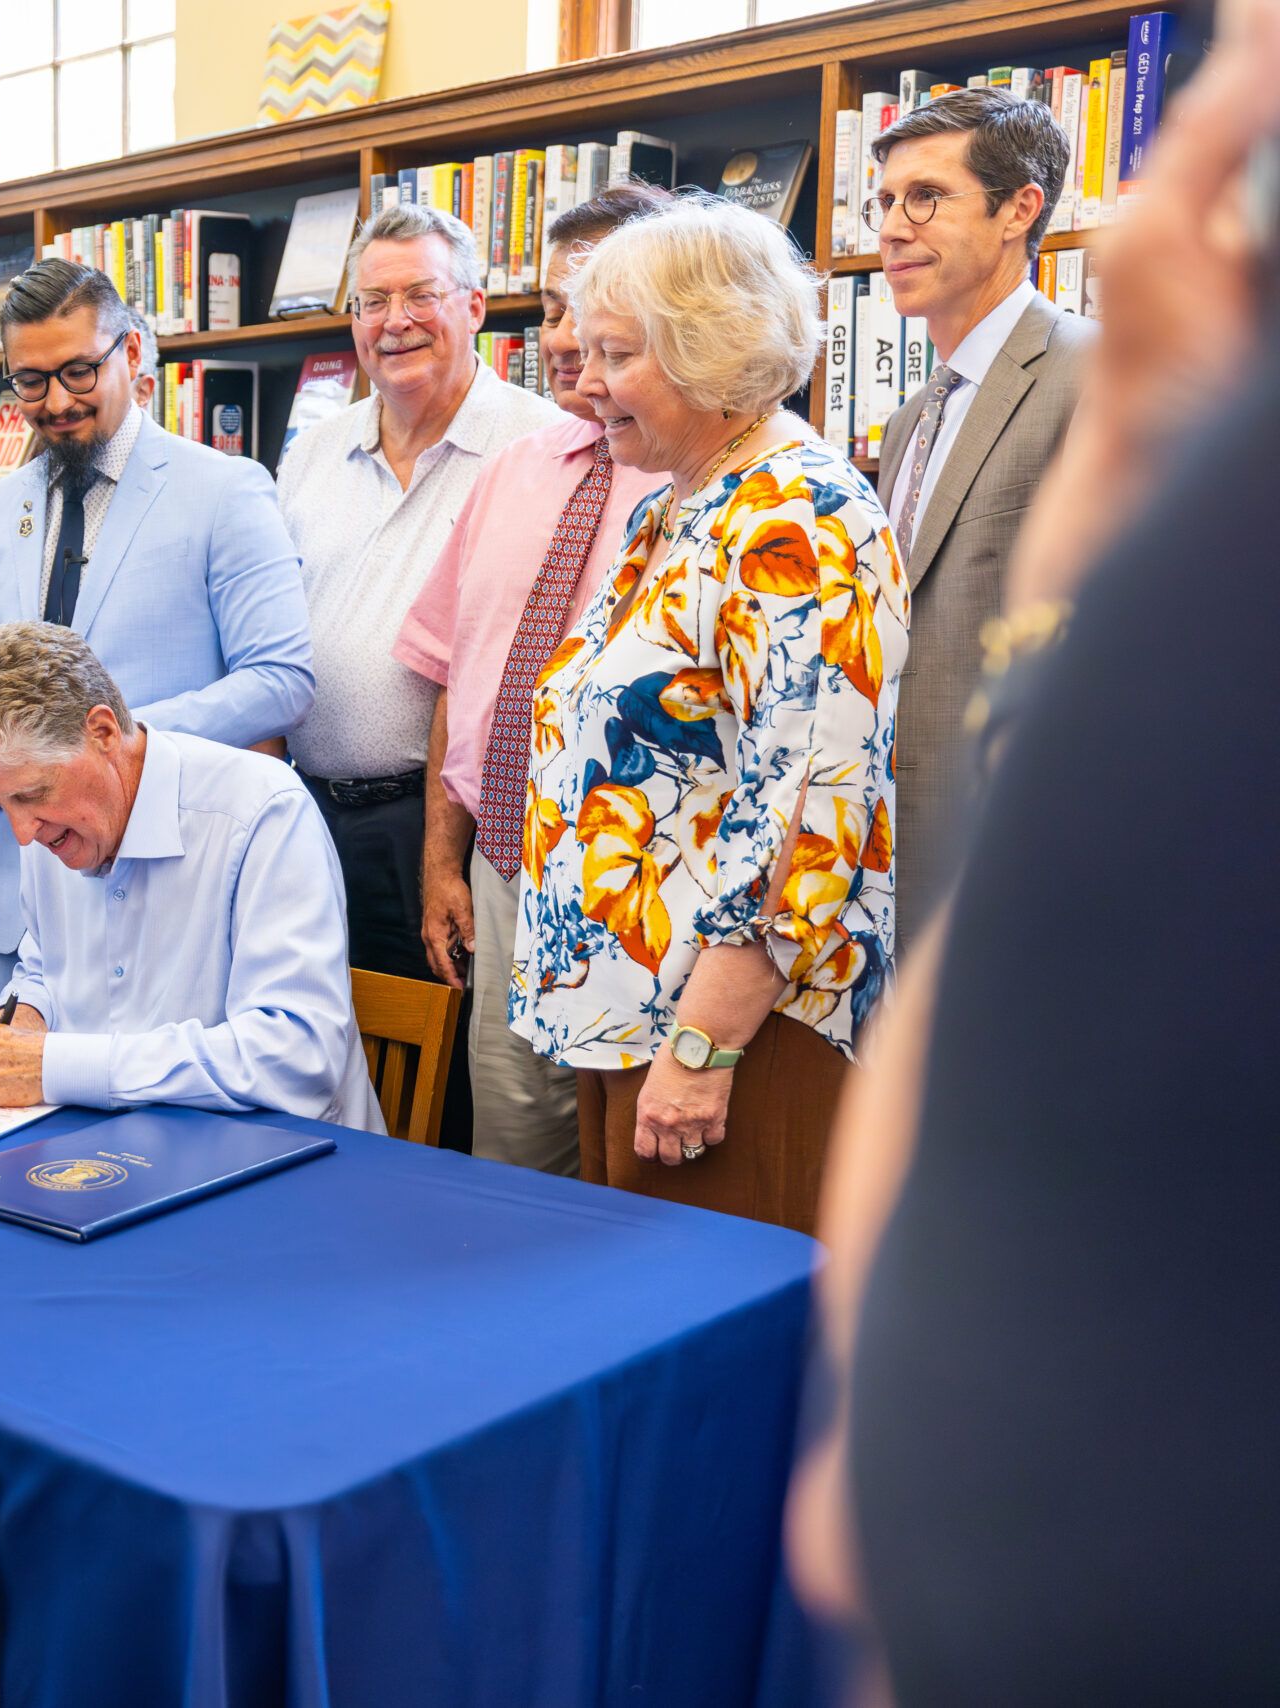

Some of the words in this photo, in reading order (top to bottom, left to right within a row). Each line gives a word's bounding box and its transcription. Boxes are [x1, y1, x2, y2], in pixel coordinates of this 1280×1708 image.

[1137, 52, 1150, 75] GED
[1110, 77, 1123, 124] Strategies
[1135, 75, 1146, 92] Test
[1133, 93, 1145, 114] Prep
[1132, 115, 1142, 135] 2021
[1108, 140, 1119, 167] Work
[475, 166, 486, 204] LAST
[509, 154, 527, 255] NARCONOMICS
[174, 246, 183, 283] BLOOD
[832, 325, 847, 366] GED
[875, 338, 893, 388] ACT
[907, 341, 922, 382] GRE
[831, 371, 845, 412] Test
